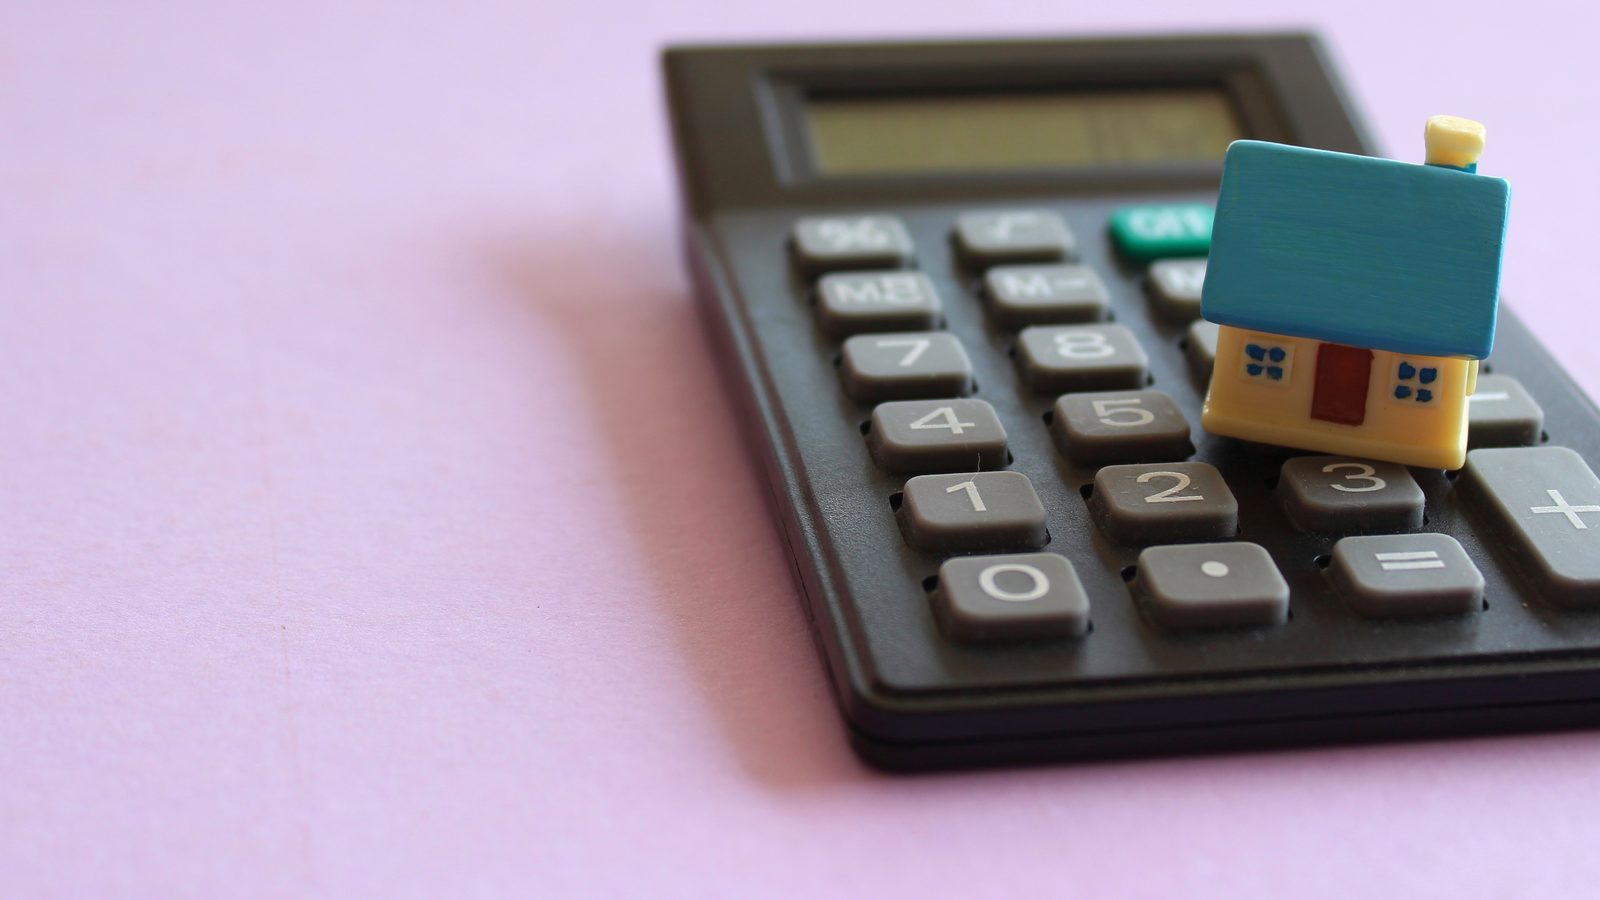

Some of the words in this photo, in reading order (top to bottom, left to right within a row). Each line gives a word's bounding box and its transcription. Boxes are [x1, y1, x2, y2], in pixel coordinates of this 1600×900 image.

[876, 340, 930, 367] 7
[1053, 332, 1116, 360] 8
[910, 407, 975, 434] 4
[1092, 399, 1155, 427] 5
[1136, 471, 1204, 503] 2
[1322, 462, 1387, 493] 3
[946, 481, 987, 511] 1
[978, 564, 1050, 601] 0
